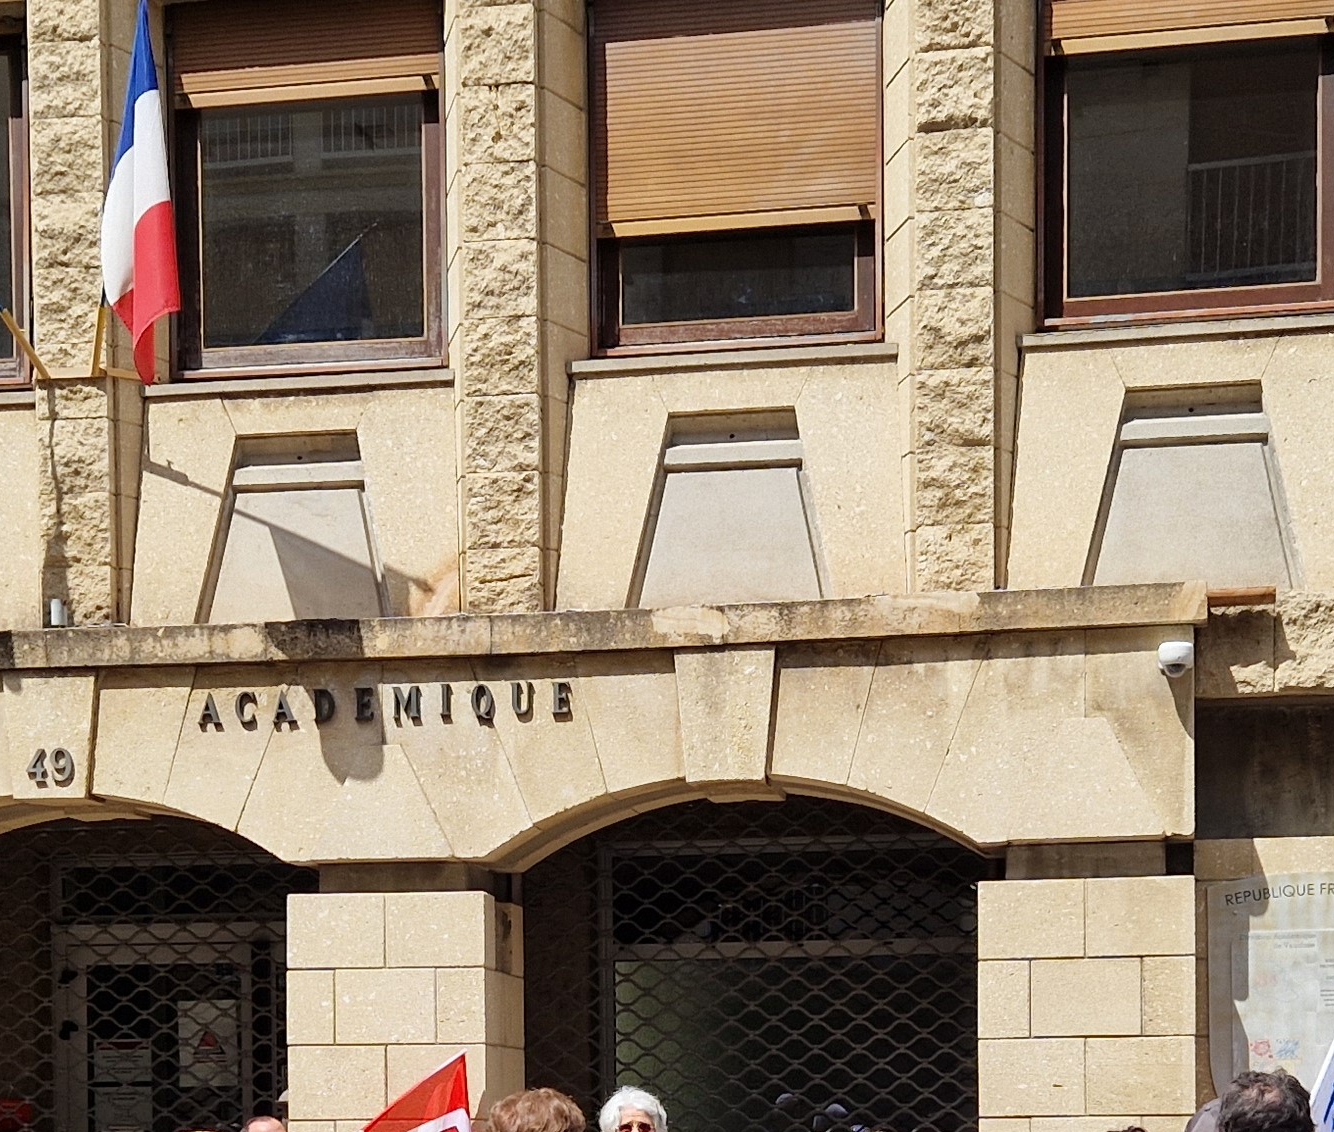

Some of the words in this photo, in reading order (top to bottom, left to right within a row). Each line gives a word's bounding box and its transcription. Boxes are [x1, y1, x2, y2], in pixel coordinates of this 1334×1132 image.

[197, 681, 572, 732] ACADEMIQUE
[26, 747, 76, 789] 49
[1224, 883, 1315, 906] REPUBLIQUE
